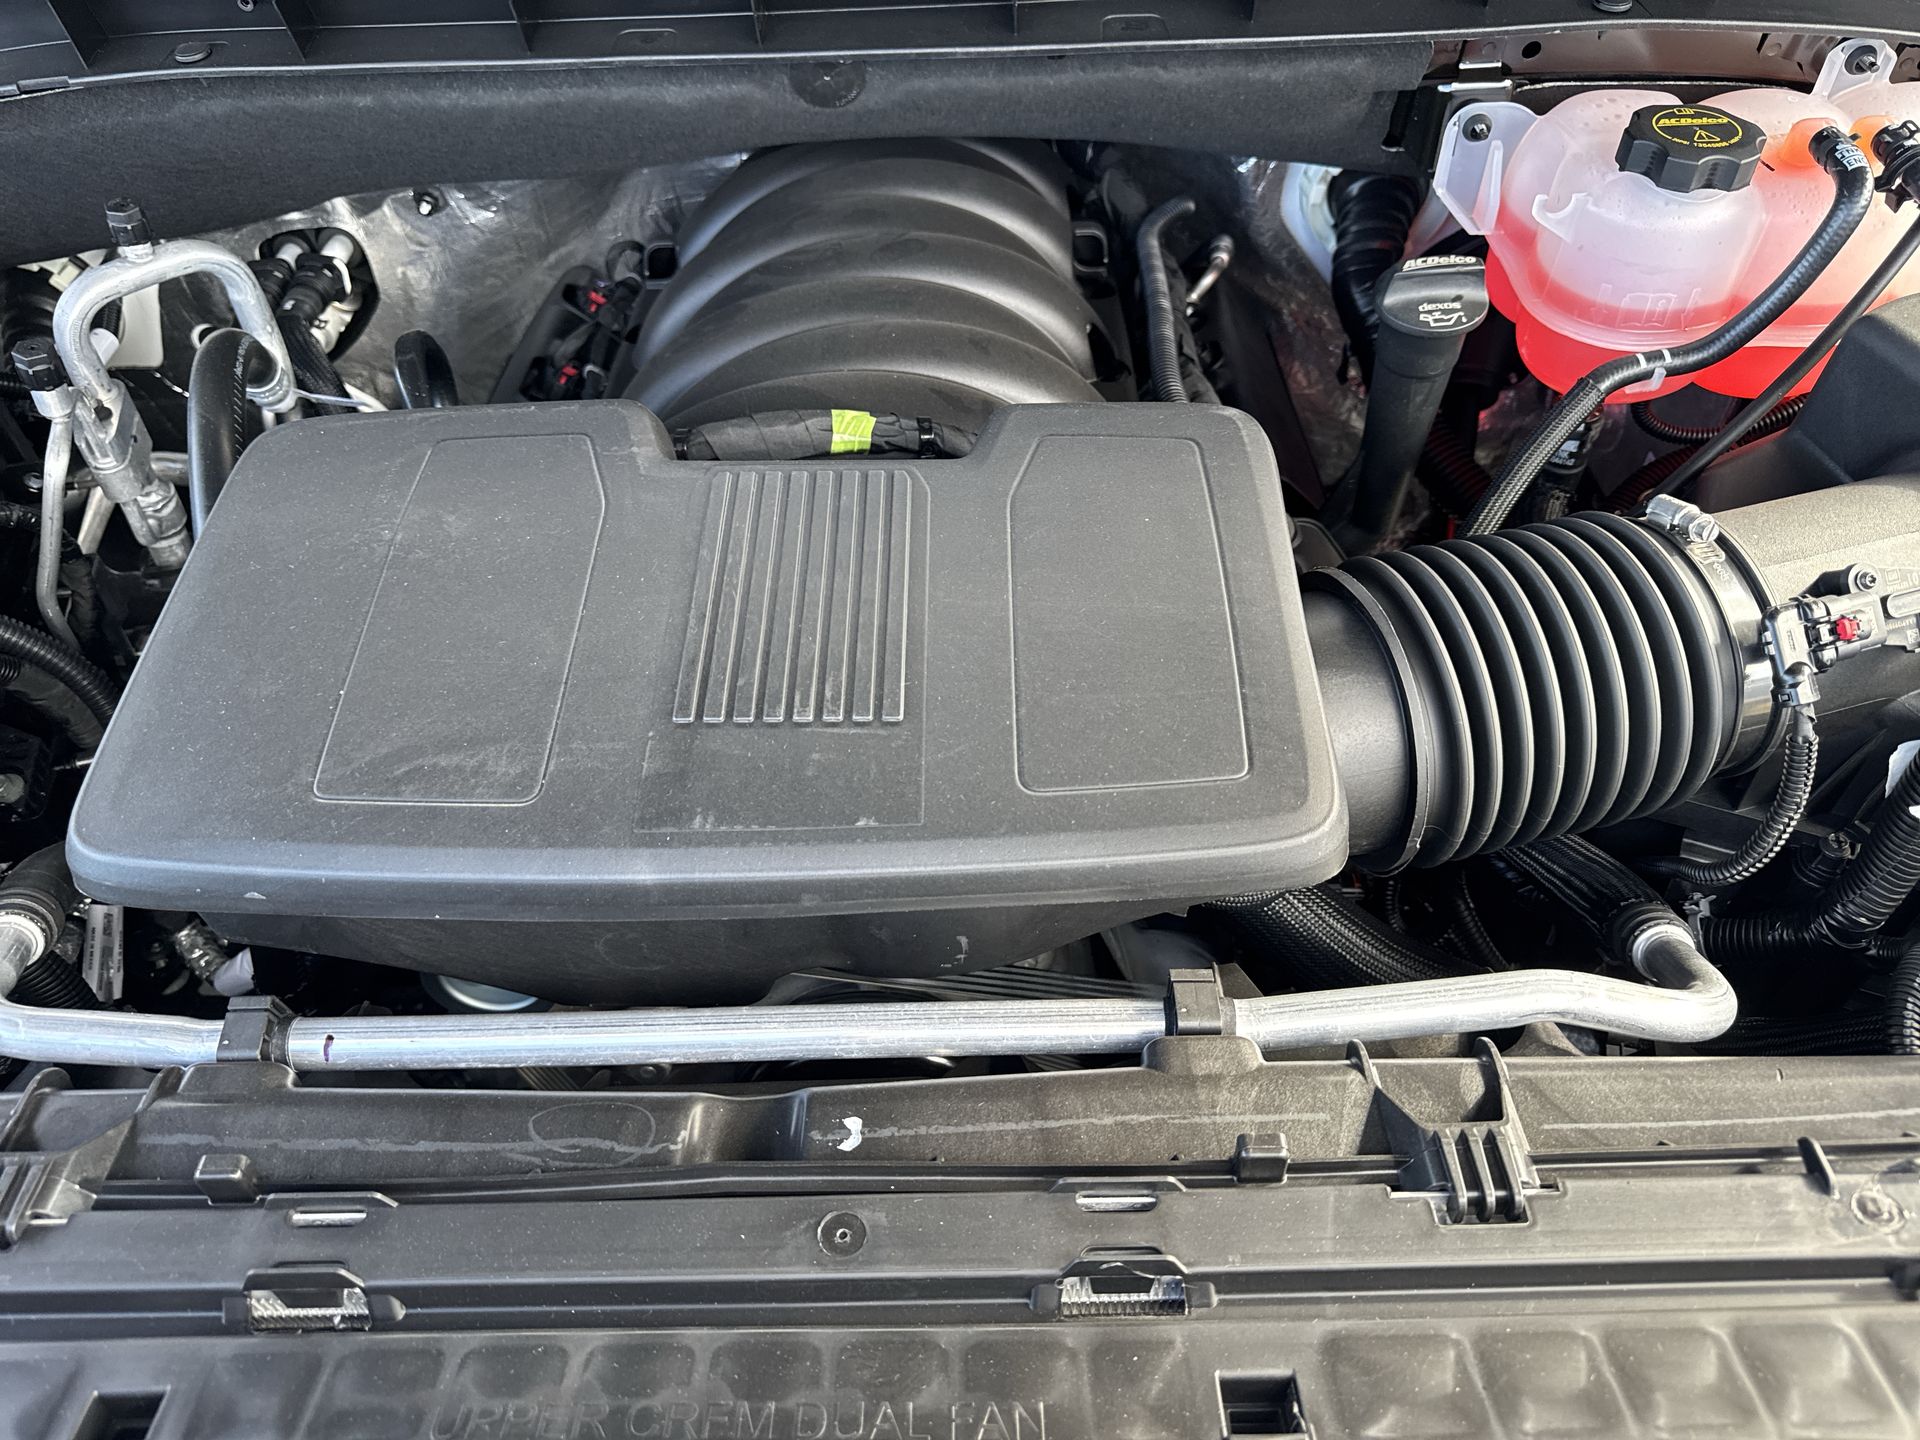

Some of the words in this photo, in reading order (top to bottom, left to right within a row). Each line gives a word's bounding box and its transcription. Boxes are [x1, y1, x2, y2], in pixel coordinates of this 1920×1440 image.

[1656, 117, 1729, 127] ACDelco
[1402, 255, 1477, 271] ACDelco
[1418, 301, 1462, 312] dexos
[797, 1400, 931, 1440] DUAL
[951, 1400, 1046, 1440] FAN
